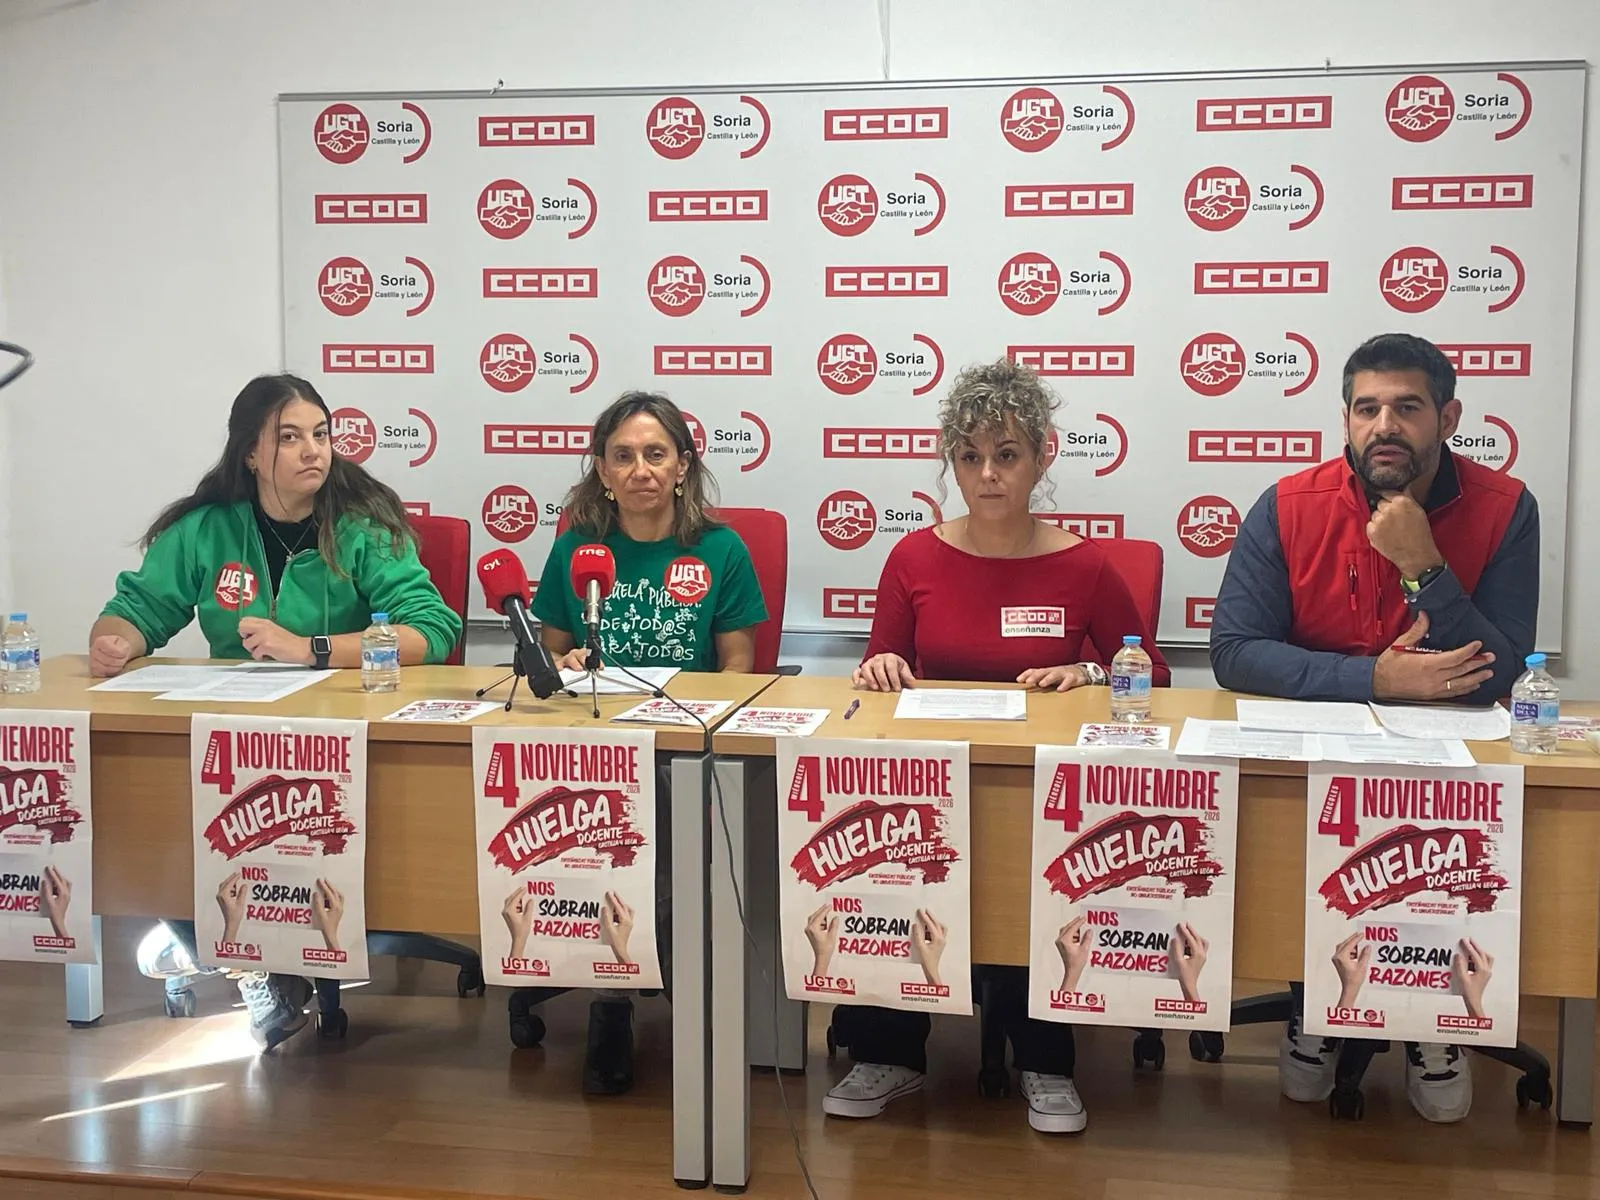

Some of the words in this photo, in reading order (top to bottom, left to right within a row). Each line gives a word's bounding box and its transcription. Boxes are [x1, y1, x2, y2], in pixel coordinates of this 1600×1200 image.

[1398, 87, 1444, 107] UGT
[1465, 94, 1508, 107] Soria
[657, 108, 696, 126] UGT
[1012, 99, 1054, 119] UGT
[1073, 105, 1113, 118] Soria
[1206, 104, 1321, 125] CCOO
[1456, 112, 1486, 120] Castilla
[1497, 111, 1517, 120] León
[324, 113, 361, 131] UGT
[377, 121, 412, 132] Soria
[714, 115, 750, 127] Soria
[833, 114, 938, 134] CCOO
[1066, 123, 1094, 131] Castilla
[1103, 122, 1121, 131] León
[487, 122, 587, 140] CCOO
[741, 131, 758, 139] León
[828, 185, 870, 203] UGT
[1196, 178, 1241, 198] UGT
[1260, 185, 1302, 198] Soria
[1402, 182, 1523, 203] CCOO
[488, 189, 525, 207] UGT
[542, 197, 578, 208] Soria
[658, 197, 759, 214] CCOO
[887, 192, 925, 204] Soria
[1014, 189, 1124, 211] CCOO
[1252, 203, 1281, 211] Castilla
[1291, 202, 1310, 211] León
[323, 201, 419, 217] CCOO
[328, 266, 365, 284] UGT
[658, 266, 696, 284] UGT
[1010, 263, 1051, 283] UGT
[1070, 271, 1110, 283] Soria
[1204, 267, 1319, 288] CCOO
[1392, 258, 1438, 279] UGT
[1459, 266, 1502, 279] Soria
[381, 275, 415, 286] Soria
[491, 275, 590, 291] CCOO
[714, 274, 751, 285] Soria
[834, 273, 939, 290] CCOO
[330, 350, 426, 367] CCOO
[490, 343, 527, 361] UGT
[544, 352, 579, 363] Soria
[663, 352, 763, 369] CCOO
[828, 344, 869, 362] UGT
[886, 353, 924, 364] Soria
[1015, 352, 1125, 370] CCOO
[1192, 344, 1236, 364] UGT
[1255, 352, 1296, 364] Soria
[914, 369, 931, 377] León
[1285, 369, 1304, 377] León
[331, 417, 367, 433] UGT
[384, 427, 419, 437] Soria
[491, 430, 592, 448] CCOO
[714, 430, 751, 441] Soria
[832, 433, 936, 453] CCOO
[1067, 433, 1107, 444] Soria
[1452, 435, 1496, 447] Soria
[1197, 437, 1313, 457] CCOO
[492, 495, 529, 513] UGT
[827, 500, 868, 518] UGT
[885, 509, 922, 521] Soria
[1188, 506, 1232, 524] UGT
[579, 548, 605, 556] rne
[220, 568, 254, 592] UGT
[670, 564, 706, 584] UGT
[831, 594, 877, 613] CC
[600, 618, 620, 630] DE
[1007, 612, 1047, 622] CCOO
[202, 731, 235, 794] 4
[237, 731, 351, 773] NOVIEMBRE
[484, 743, 520, 808] 4
[520, 743, 639, 783] NOVIEMBRE
[787, 756, 824, 822] 4
[826, 756, 952, 797] NOVIEMBRE
[1044, 763, 1083, 832] 4
[1087, 764, 1221, 811] NOVIEMBRE
[17, 805, 60, 822] DOCENTE
[220, 783, 322, 847] HUELGA
[1318, 776, 1360, 847] 4
[1363, 778, 1504, 822] NOVIEMBRE
[289, 815, 334, 833] DOCENTE
[505, 794, 611, 861] HUELGA
[576, 827, 623, 844] DOCENTE
[808, 808, 922, 877] HUELGA
[885, 842, 935, 861] DOCENTE
[1063, 821, 1185, 888] HUELGA
[242, 866, 268, 881] NOS
[1146, 855, 1199, 874] DOCENTE
[1339, 833, 1467, 904] HUELGA
[1426, 868, 1481, 889] DOCENTE
[252, 884, 310, 904] SOBRAN
[528, 881, 555, 895] NOS
[247, 904, 312, 924] RAZONES
[538, 899, 599, 918] SOBRAN
[832, 897, 862, 914] NOS
[844, 917, 910, 936] SOBRAN
[1087, 910, 1119, 926] NOS
[533, 919, 600, 939] RAZONES
[1366, 926, 1398, 941] NOS
[215, 941, 241, 953] UGT
[838, 938, 911, 958] RAZONES
[1099, 929, 1169, 950] SOBRAN
[502, 957, 529, 970] UGT
[1090, 951, 1168, 972] RAZONES
[1378, 945, 1451, 967] SOBRAN
[804, 975, 833, 988] UGT
[1369, 967, 1452, 989] RAZONES
[1050, 990, 1082, 1004] UGT
[1327, 1007, 1361, 1020] UGT
